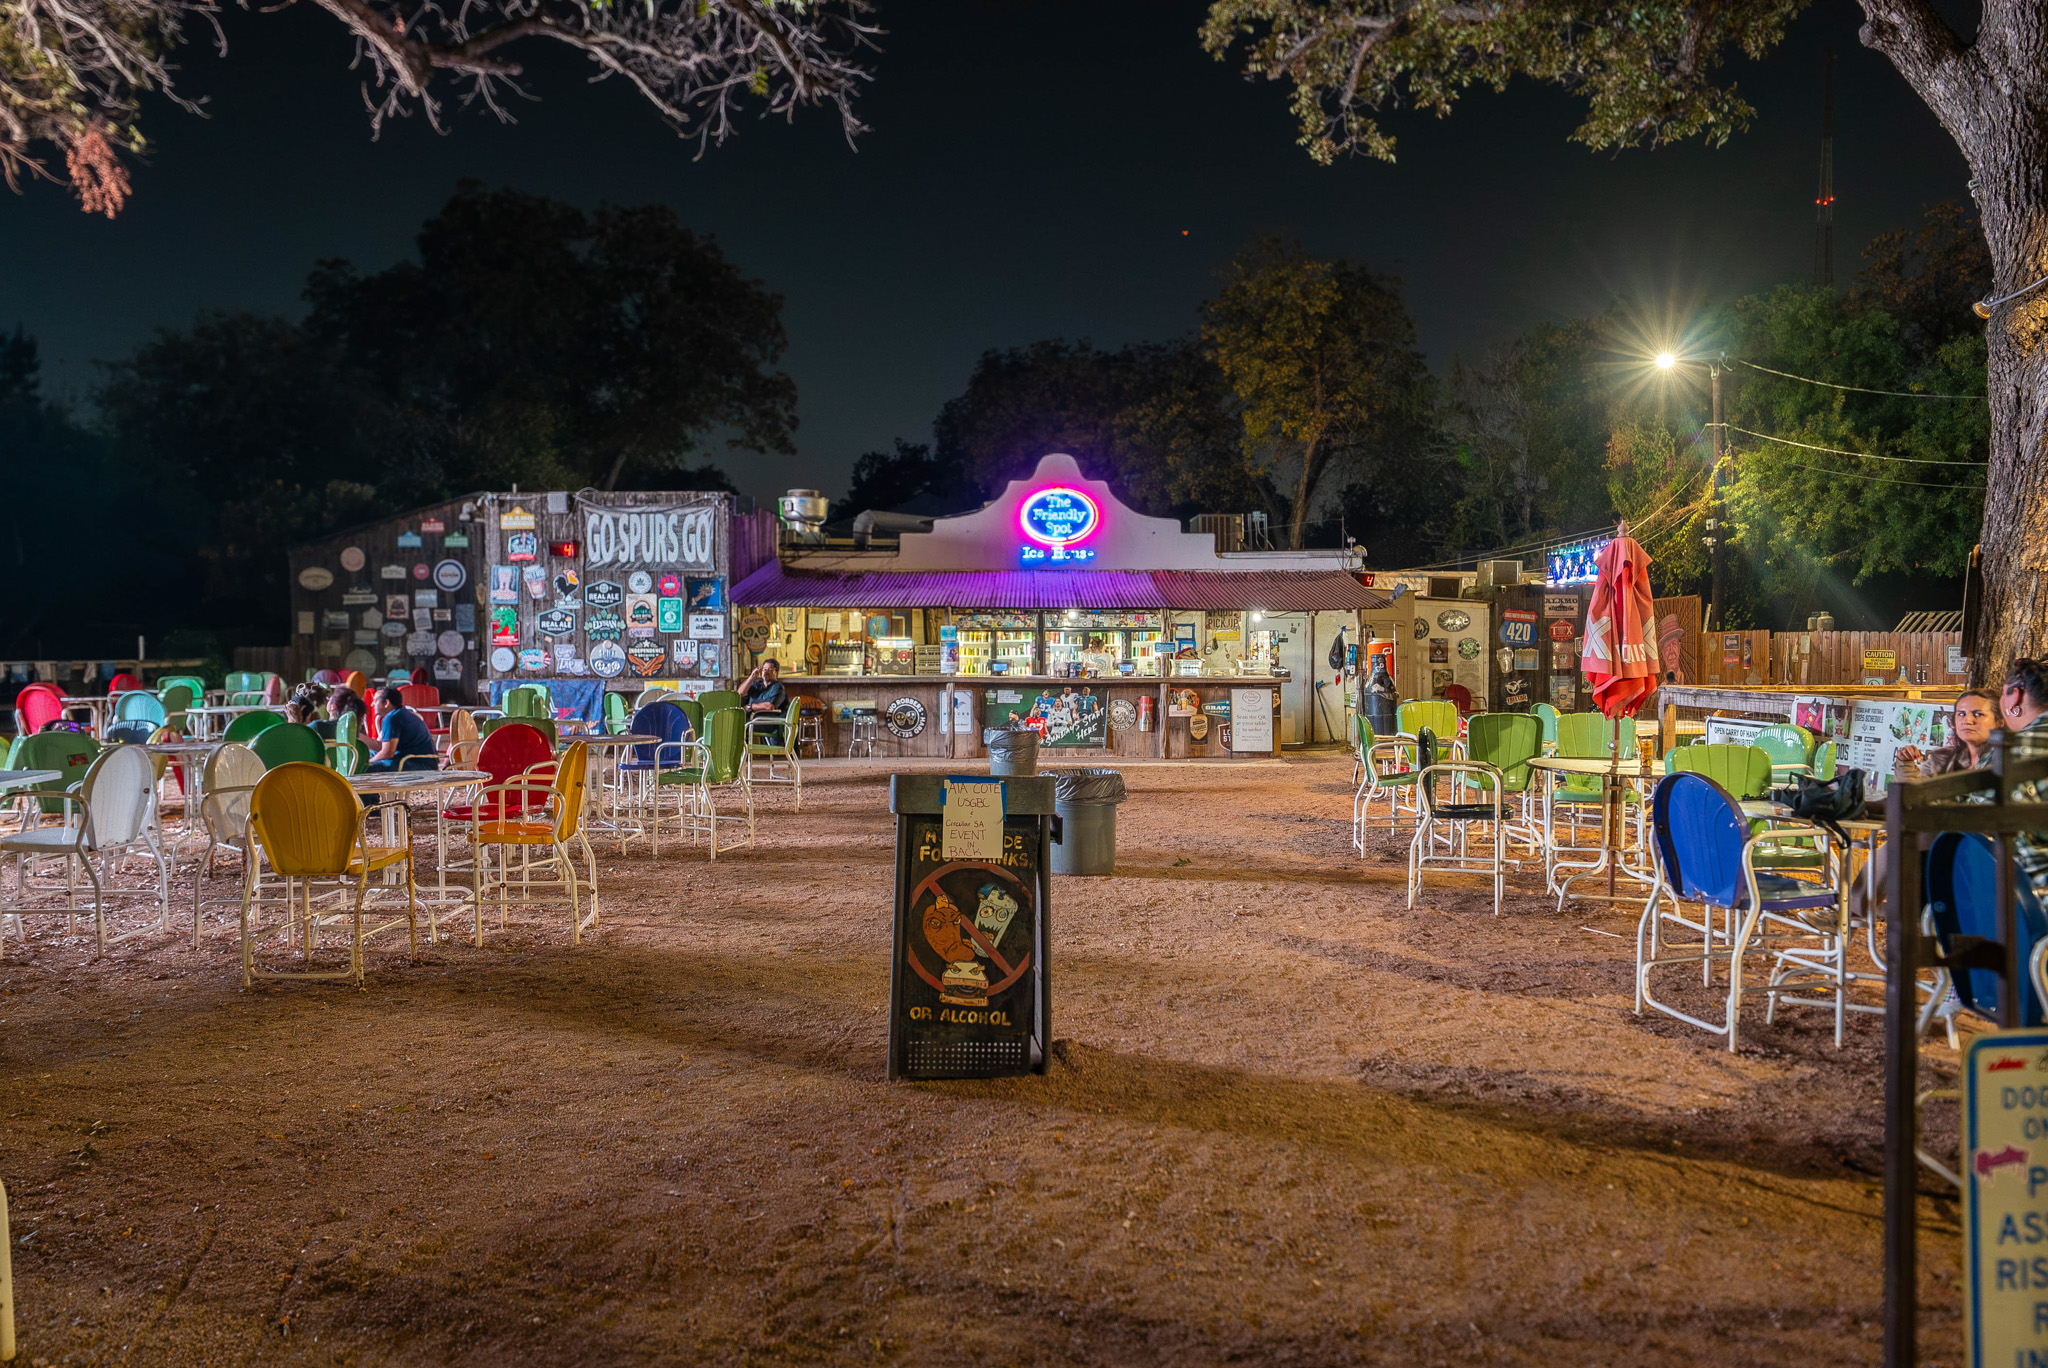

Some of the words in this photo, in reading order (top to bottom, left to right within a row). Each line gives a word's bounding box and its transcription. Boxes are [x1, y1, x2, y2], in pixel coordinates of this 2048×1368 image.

[1046, 495, 1071, 508] The
[1033, 509, 1086, 523] Friendly
[1046, 522, 1072, 536] Spot
[587, 513, 615, 563] GO
[618, 513, 679, 563] SPURS
[682, 513, 711, 563] GO
[563, 544, 572, 557] 4
[1022, 547, 1045, 559] Ice
[1366, 576, 1374, 586] 4
[541, 621, 558, 629] REAL
[559, 621, 572, 629] ALE
[1507, 622, 1531, 642] 420
[675, 641, 696, 653] NVP
[886, 703, 897, 718] TWO
[895, 698, 924, 713] ROBBERS
[887, 722, 913, 738] SELTZER
[913, 716, 926, 734] HARD
[1076, 722, 1098, 740] HERE
[1714, 726, 1725, 735] OPEN
[1725, 728, 1739, 736] CARRY
[973, 783, 1001, 794] COTE
[957, 797, 990, 808] USGBC
[950, 829, 987, 840] EVENT
[948, 846, 982, 857] BACK
[909, 1006, 932, 1020] OR
[940, 1008, 1012, 1026] ALCOHOL
